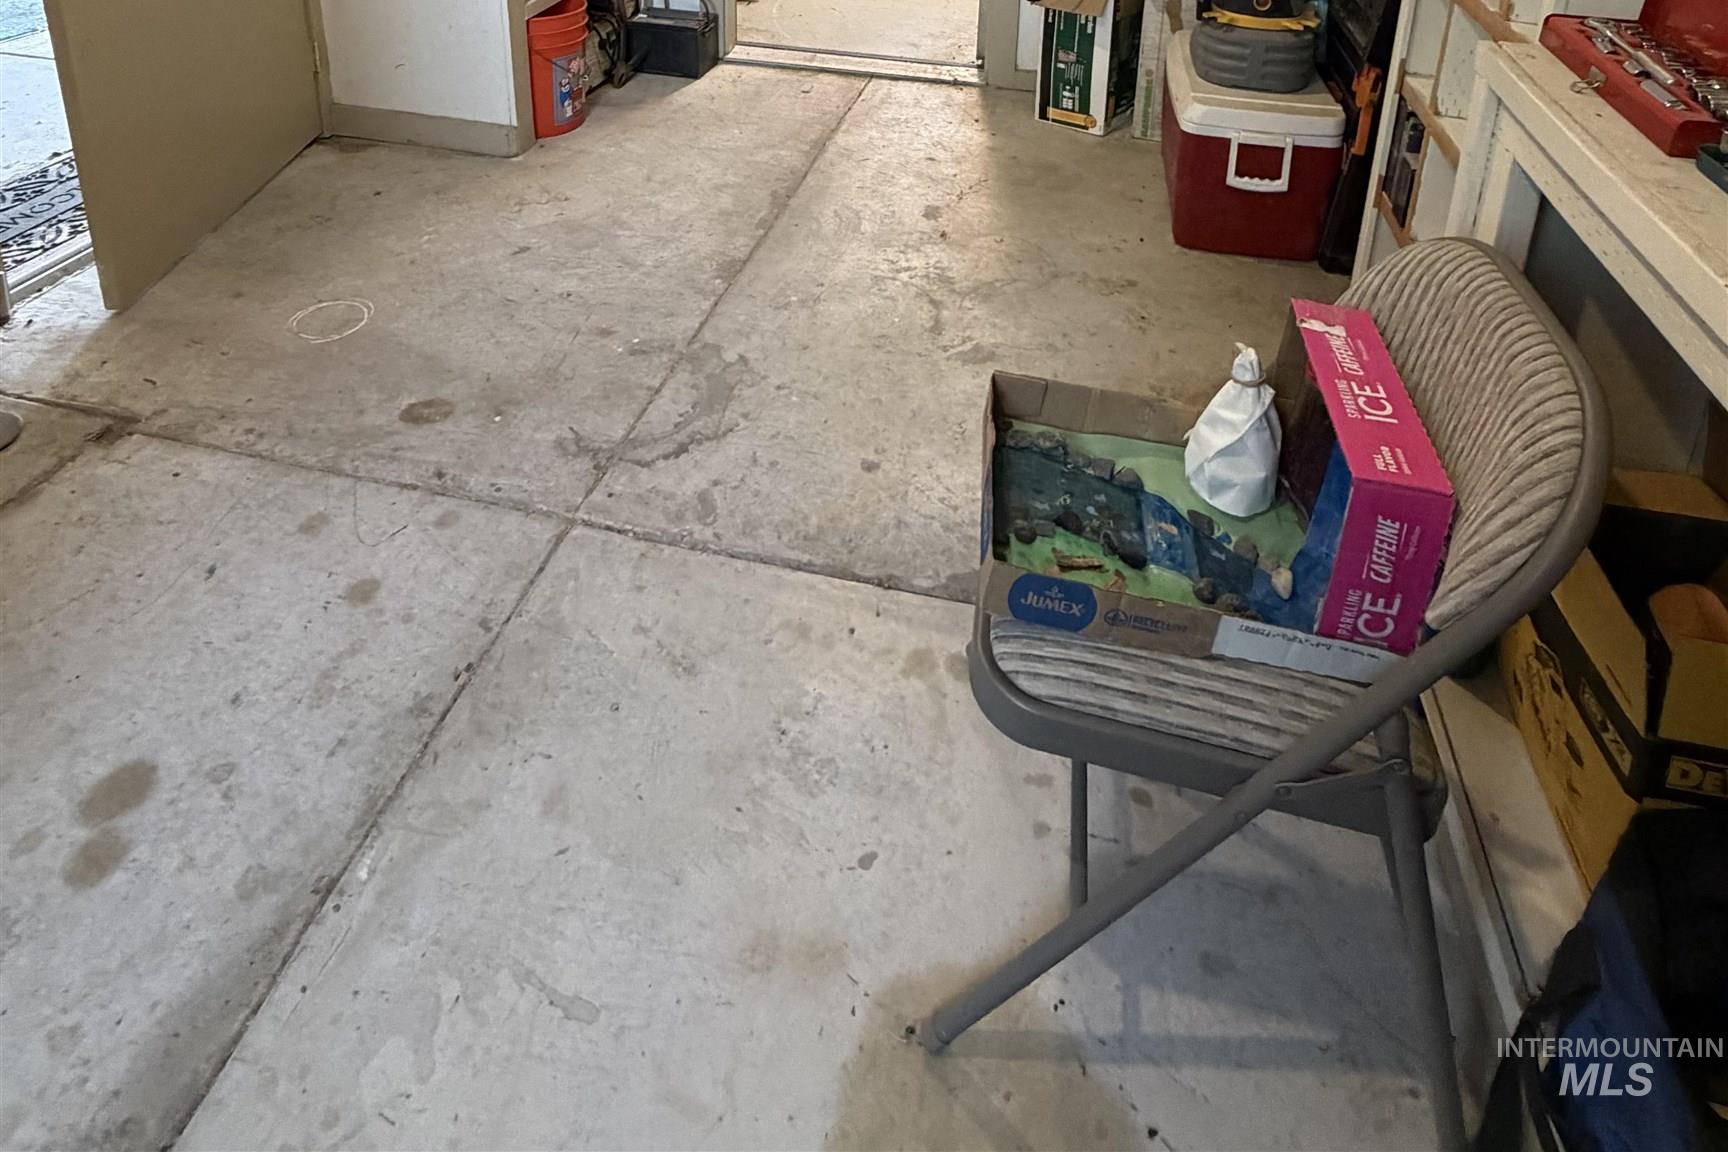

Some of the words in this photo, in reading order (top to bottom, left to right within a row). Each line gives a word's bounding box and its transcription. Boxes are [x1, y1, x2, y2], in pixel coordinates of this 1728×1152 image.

[1335, 379, 1362, 419] SPARKLING
[1350, 381, 1399, 423] ICE
[1369, 515, 1400, 583] CAFFEINE
[1020, 591, 1084, 617] JUMEX
[1336, 589, 1362, 638] PARKLING
